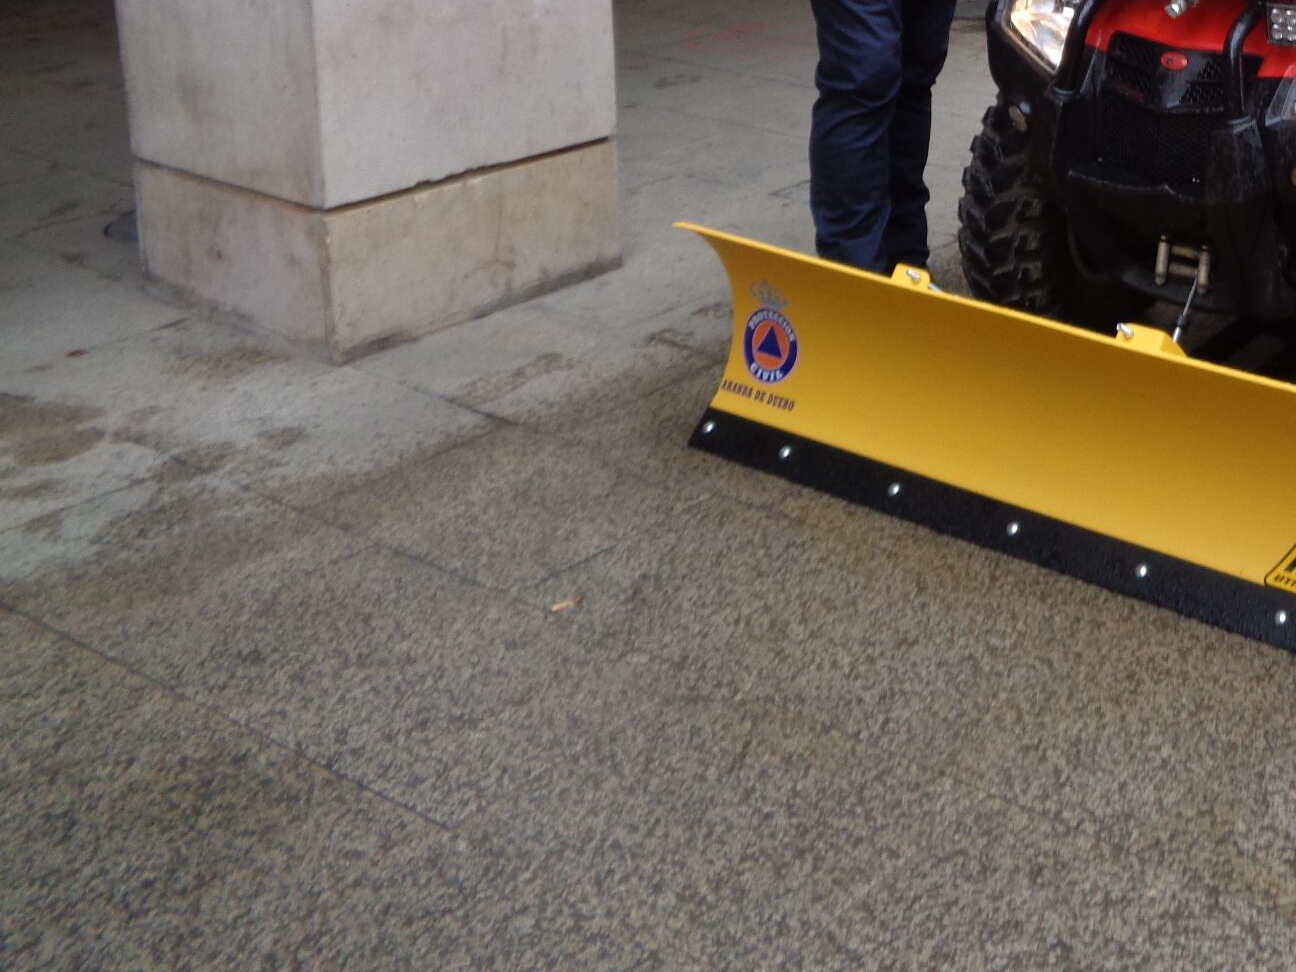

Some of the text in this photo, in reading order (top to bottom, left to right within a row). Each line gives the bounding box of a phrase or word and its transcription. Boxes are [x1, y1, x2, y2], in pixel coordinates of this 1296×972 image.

[750, 362, 783, 381] CIVIL
[754, 389, 766, 402] DE
[766, 394, 796, 412] DUERO
